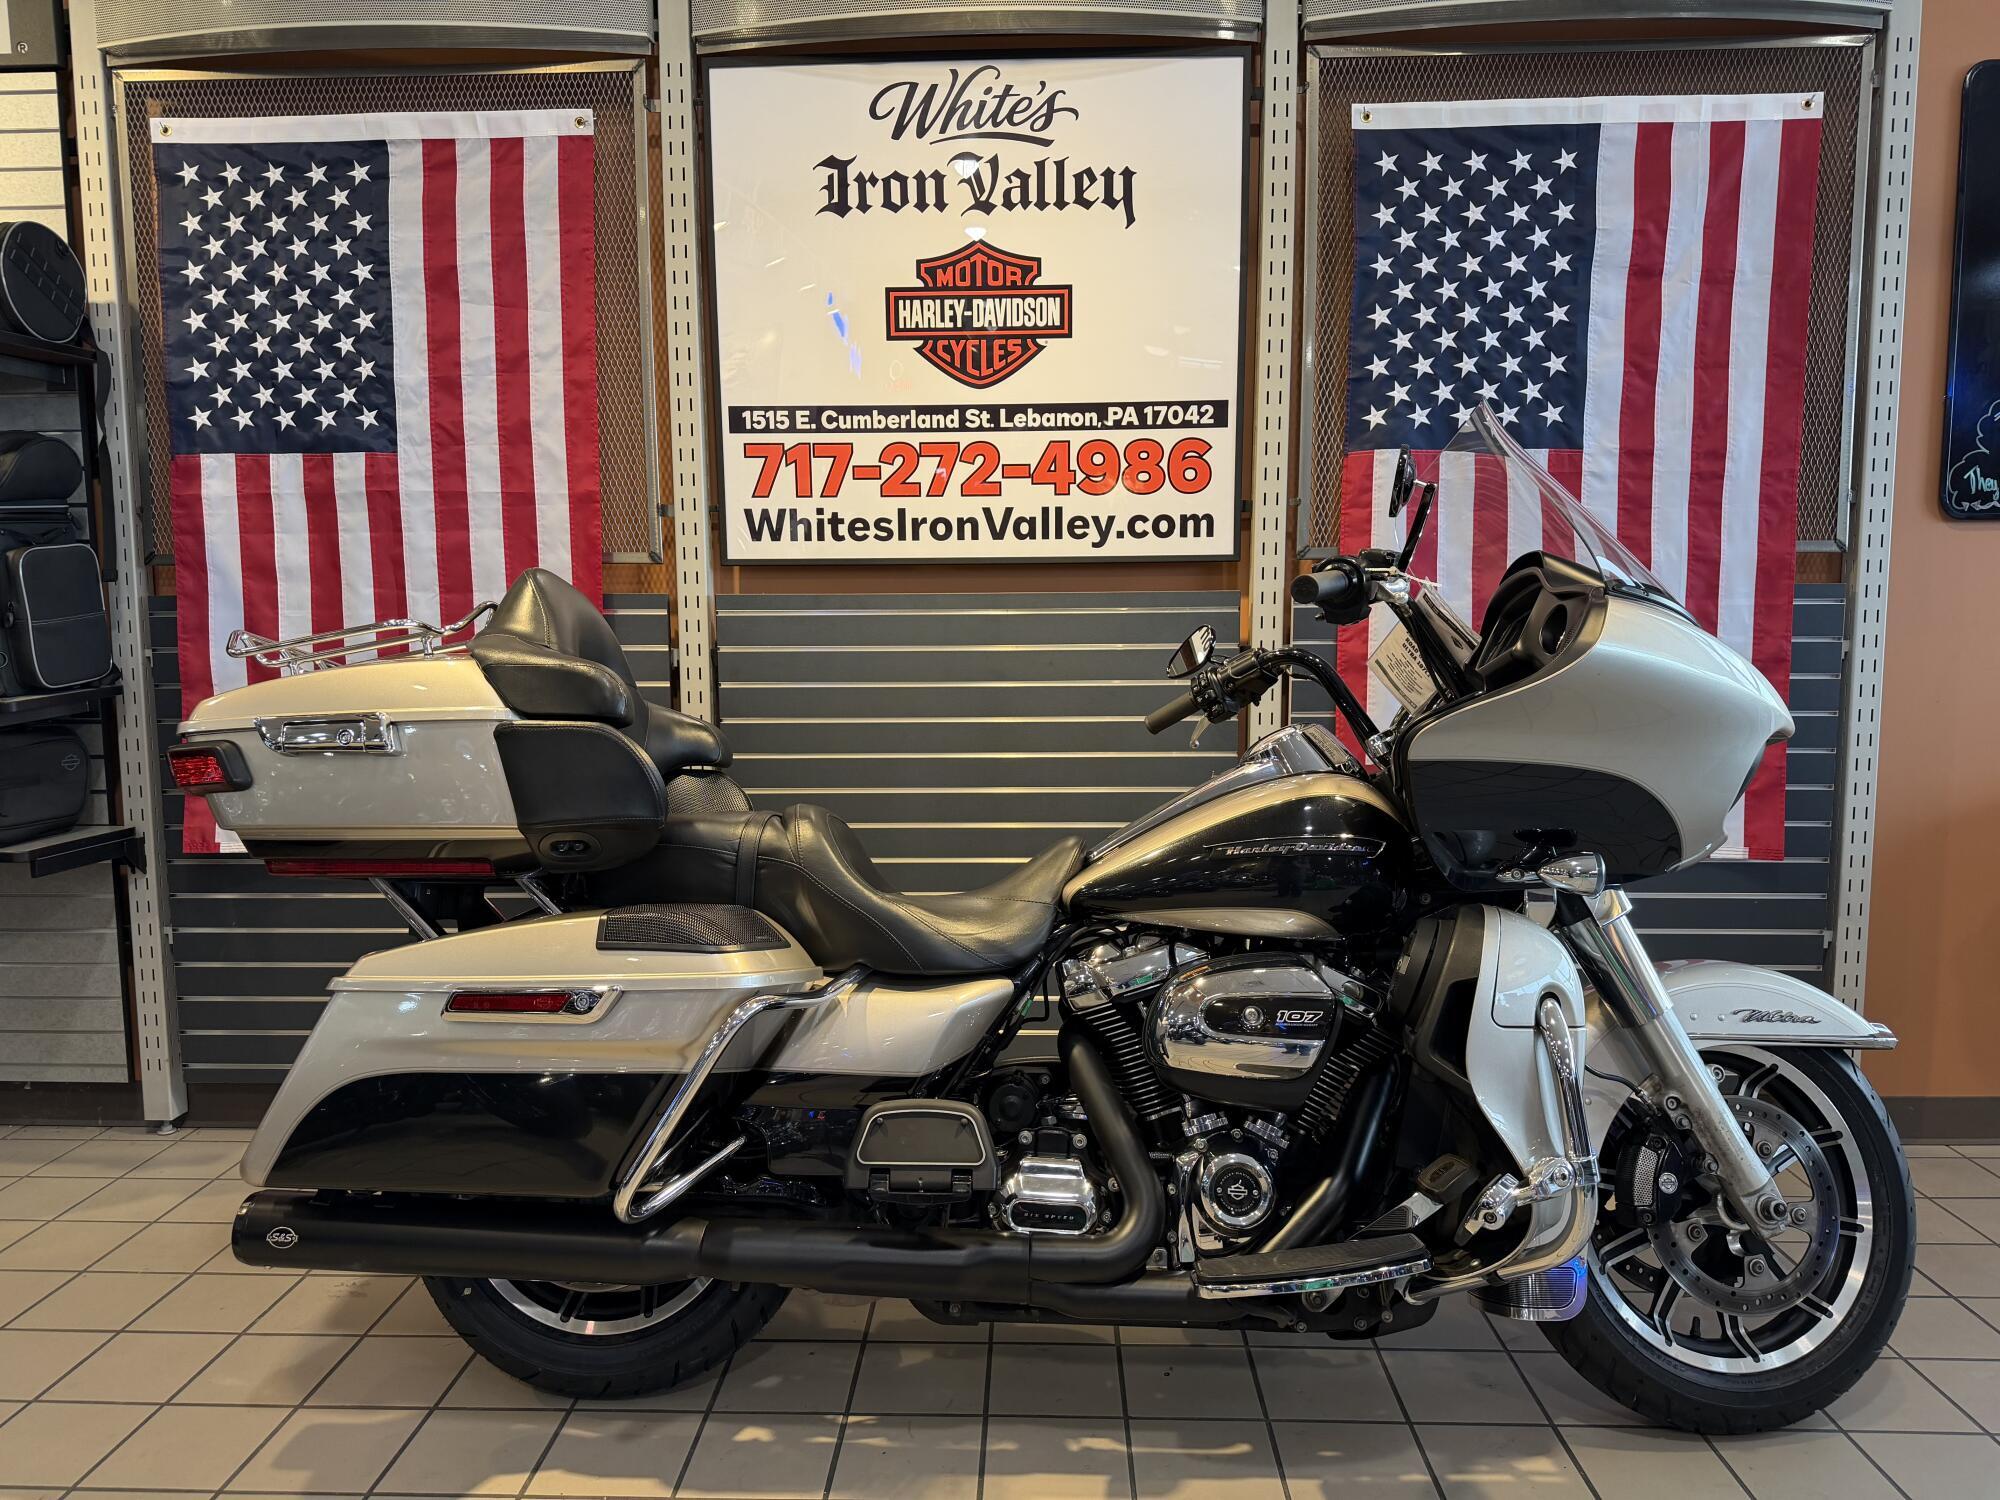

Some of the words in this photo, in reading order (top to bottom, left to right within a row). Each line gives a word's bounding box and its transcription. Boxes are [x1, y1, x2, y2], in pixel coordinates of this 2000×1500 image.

[869, 65, 1079, 147] White's
[812, 154, 949, 219] Iron
[947, 151, 1137, 229] Valley
[936, 253, 1022, 287] MOTOR
[898, 297, 1061, 329] HARLEY-DAVIDSON
[936, 338, 1022, 377] CYCLES
[741, 410, 790, 430] 1515
[795, 410, 817, 430] E.
[821, 409, 960, 430] Cumberland
[965, 408, 995, 429] St.
[1143, 404, 1215, 426] 17042
[743, 437, 1213, 499] 717-272-4986
[743, 506, 1215, 549] WhitesIronValley.com
[1276, 1010, 1324, 1023] 107
[1732, 1009, 1822, 1024] Ultra
[270, 1232, 293, 1242] S&S
